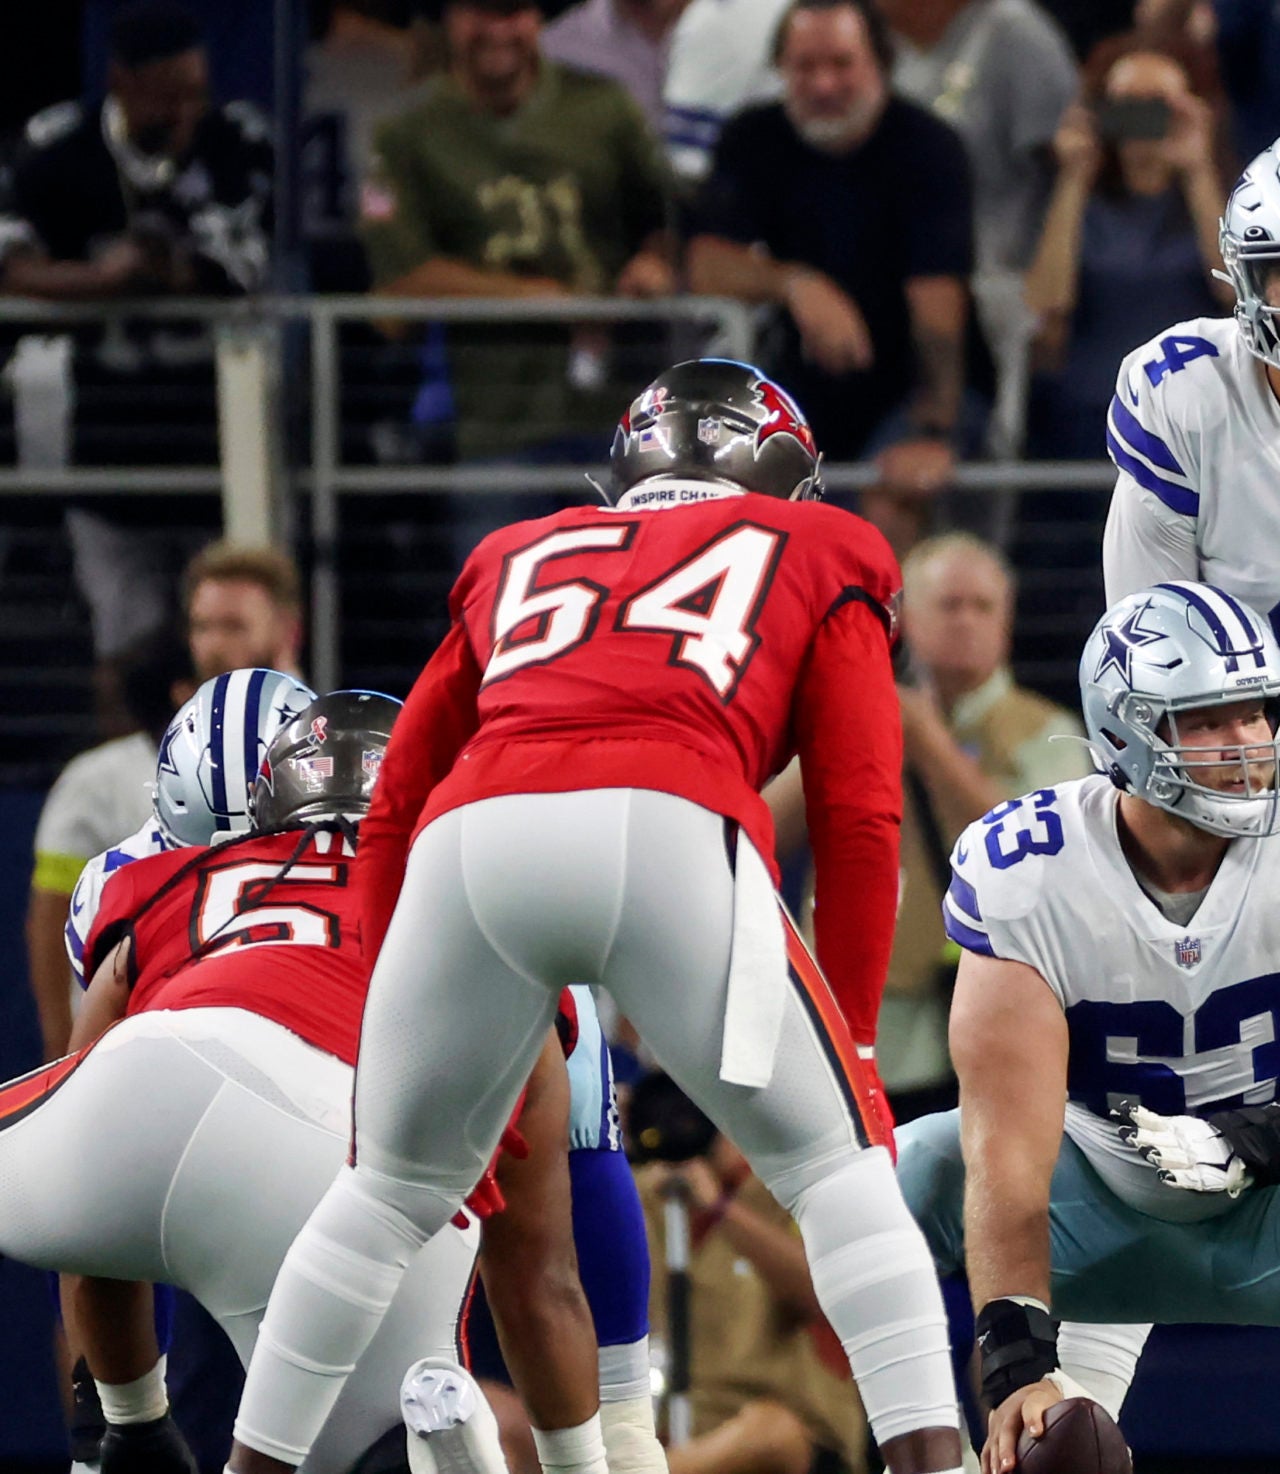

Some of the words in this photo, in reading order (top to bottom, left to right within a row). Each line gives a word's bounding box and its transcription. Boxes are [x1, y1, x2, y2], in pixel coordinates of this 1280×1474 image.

[1144, 334, 1219, 388] 4
[630, 490, 676, 506] INSPIRE
[982, 788, 1066, 871] 63
